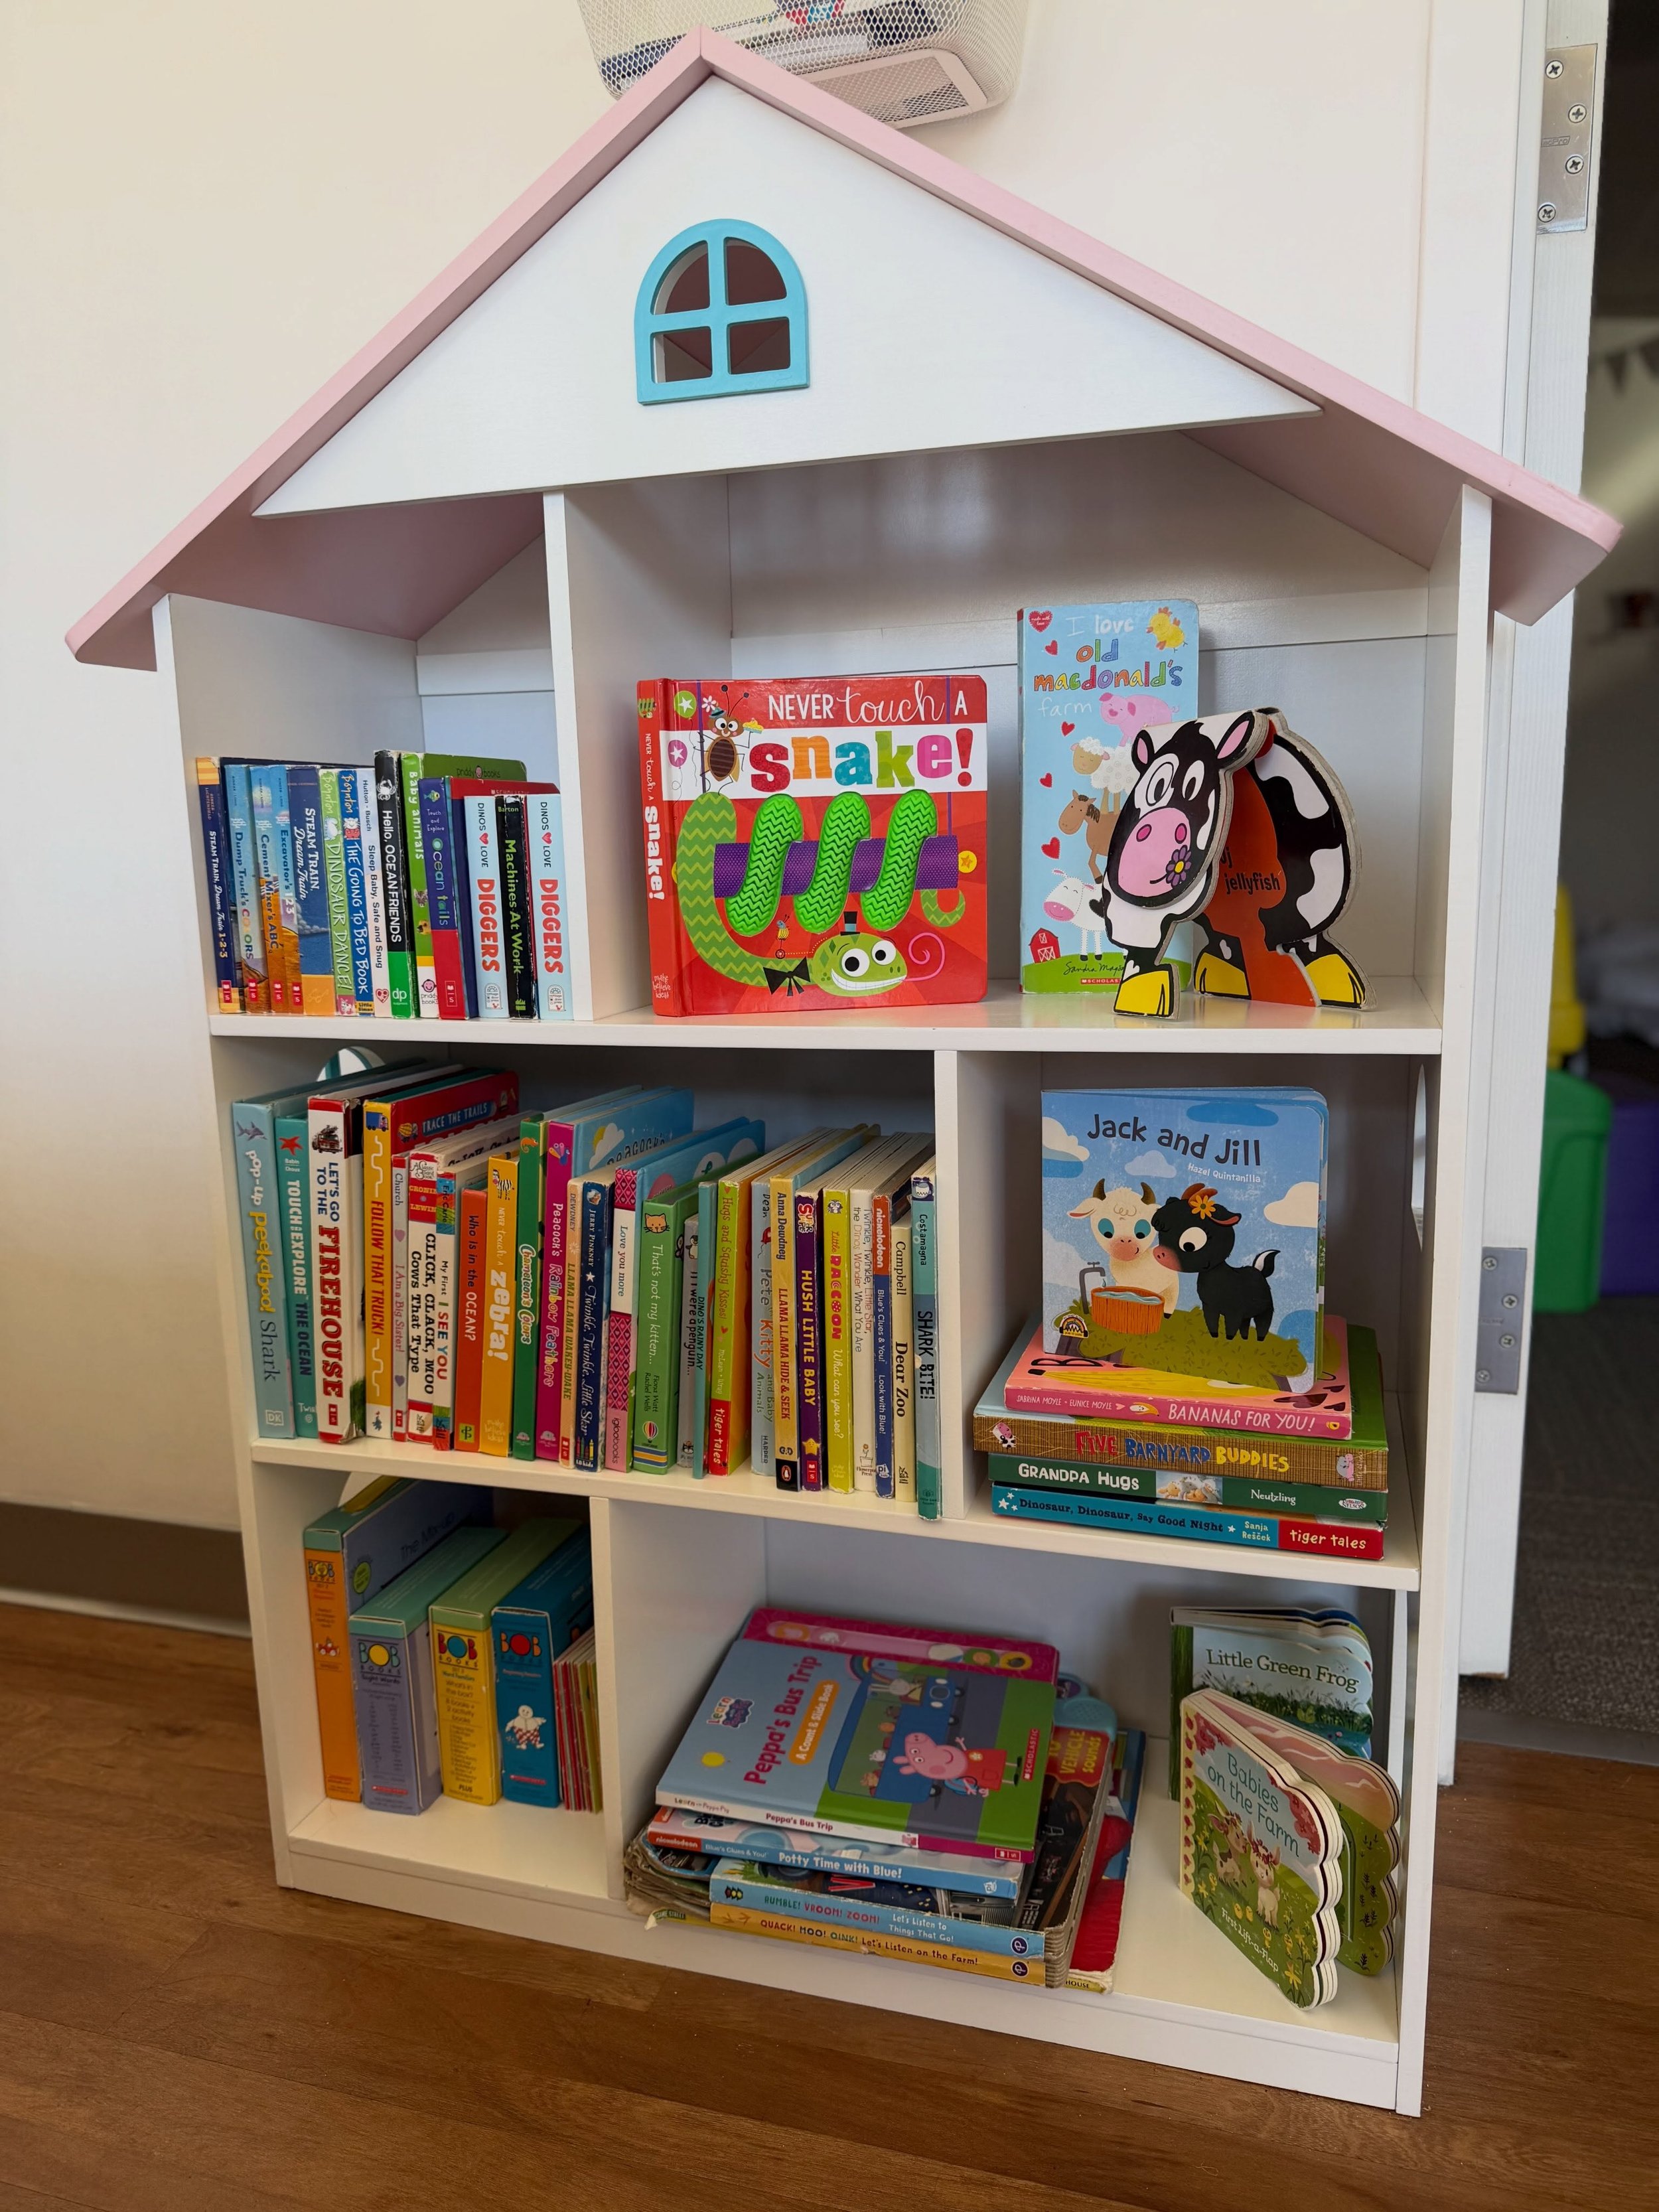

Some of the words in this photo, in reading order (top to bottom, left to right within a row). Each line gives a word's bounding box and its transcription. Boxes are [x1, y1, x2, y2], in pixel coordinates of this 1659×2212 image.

[1065, 616, 1085, 636] I
[1096, 615, 1134, 634] love
[1076, 638, 1118, 662] old
[1034, 660, 1183, 692] macdonald's
[768, 694, 833, 721] NEVER
[837, 680, 945, 724] touch
[954, 690, 968, 716] A
[1038, 697, 1092, 717] farm
[749, 727, 974, 792] snake!
[382, 811, 394, 842] Hello,
[385, 846, 398, 891] OCEAN
[433, 838, 445, 890] Ocean
[505, 840, 518, 907] Machines
[370, 874, 378, 899] Baby,
[1224, 872, 1281, 895] jellyfish
[388, 894, 401, 942] FRIENDS
[437, 896, 450, 926] tails
[477, 879, 500, 972] DIGGERS
[510, 911, 521, 930] At
[512, 932, 524, 974] Work
[423, 1118, 445, 1133] TRACE
[448, 1113, 461, 1124] THE
[464, 1104, 487, 1120] TRAILS
[1087, 1114, 1147, 1143] Jack
[1157, 1128, 1209, 1159] and
[1214, 1138, 1261, 1166] Jill
[246, 1150, 263, 1206] pop-up
[317, 1167, 326, 1185] TO
[329, 1162, 339, 1198] LET'S
[1188, 1163, 1210, 1177] Hazel
[1213, 1170, 1261, 1183] Quintanilla
[287, 1180, 303, 1224] TOUCH
[318, 1189, 328, 1215] THE
[330, 1201, 340, 1222] GO
[720, 1198, 733, 1220] Hugs
[371, 1201, 384, 1250] FOLLOW
[619, 1226, 628, 1249] Love
[722, 1226, 731, 1242] and
[853, 1224, 862, 1250] Dinos
[863, 1209, 871, 1244] Twinkle,
[918, 1214, 928, 1266] Costamagna
[250, 1211, 275, 1313] peekaboo!
[291, 1232, 307, 1295] EXPLORE
[371, 1254, 384, 1288] THAT
[411, 1250, 421, 1288] Cows
[422, 1233, 436, 1288] CLICK,
[651, 1244, 664, 1277] That's
[718, 1247, 731, 1284] Squishy
[895, 1241, 906, 1295] Campbell
[650, 1280, 659, 1299] not
[719, 1289, 729, 1319] Kisses!
[801, 1270, 813, 1312] HUSH
[296, 1302, 308, 1328] THE
[319, 1225, 343, 1398] FIREHOUSE
[371, 1290, 384, 1336] TRUCK!
[411, 1294, 421, 1329] That
[423, 1294, 435, 1353] CLACK,
[647, 1303, 658, 1320] my
[864, 1315, 873, 1335] Star,
[260, 1319, 281, 1381] Shark
[648, 1323, 661, 1365] kitten...
[803, 1318, 814, 1363] LITTLE
[855, 1337, 863, 1353] Are
[918, 1311, 934, 1357] SHARK
[298, 1332, 312, 1376] OCEAN
[409, 1335, 421, 1372] Type
[895, 1341, 908, 1383] Dear
[425, 1359, 434, 1394] MOO
[804, 1368, 816, 1406] BABY
[920, 1364, 935, 1399] BITE!
[896, 1388, 908, 1418] Zoo
[1016, 1395, 1040, 1404] SABRINA
[1069, 1399, 1090, 1408] EUNICE
[1092, 1402, 1112, 1410] MOYLE
[1168, 1404, 1241, 1426] BANANAS
[1245, 1410, 1270, 1428] FOR
[1275, 1413, 1315, 1432] YOU!
[714, 1408, 725, 1434] tiger
[612, 1417, 621, 1464] igloobooks
[713, 1438, 723, 1464] tales
[1075, 1430, 1119, 1456] FIVE
[1125, 1437, 1212, 1465] BARNYARD
[1216, 1446, 1290, 1472] BUDDIES
[1018, 1463, 1090, 1484] GRANDPA
[1098, 1471, 1139, 1491] Hugs
[1251, 1489, 1296, 1506] Neutzling
[1019, 1499, 1074, 1514] Dinosaur,
[1077, 1505, 1133, 1521] Dinosaur,
[1137, 1513, 1153, 1523] Say
[1158, 1514, 1186, 1528] Good
[1190, 1518, 1223, 1532] Night
[1245, 1521, 1269, 1532] Sanja
[1290, 1530, 1326, 1545] tiger
[1330, 1534, 1366, 1550] tales
[438, 1632, 478, 1660] BOB
[1206, 1649, 1253, 1668] Little
[1257, 1655, 1311, 1679] Green
[1315, 1664, 1359, 1694] Frog
[1025, 1729, 1039, 1773] SCHOLASTIC
[1060, 1730, 1086, 1774] VEHICLE
[1228, 1752, 1279, 1814] Babies
[766, 1812, 797, 1825] Peppa's
[800, 1818, 815, 1828] Bus
[816, 1822, 833, 1832] Trip
[1208, 1765, 1226, 1793] on
[1230, 1780, 1254, 1814] the
[1258, 1802, 1299, 1858] Farm
[779, 1852, 809, 1867] Potty
[813, 1856, 840, 1870] Time
[844, 1861, 870, 1876] with
[873, 1866, 902, 1879] Blue!
[764, 1895, 800, 1909] RUMBLE!
[804, 1903, 843, 1917] VROOM!
[846, 1911, 880, 1925] ZOOM!
[760, 1919, 796, 1933] QUACK!
[800, 1926, 826, 1938] MOO!
[830, 1931, 858, 1945] OINK!
[1222, 1907, 1238, 1933] First
[1238, 1927, 1279, 1973] Lift-a-Flap
[862, 1938, 881, 1949] Let's
[885, 1940, 913, 1956] Listen
[916, 1948, 928, 1957] on
[932, 1949, 948, 1960] the
[952, 1953, 978, 1966] Farm!
[1064, 1980, 1090, 1990] HOUSE
